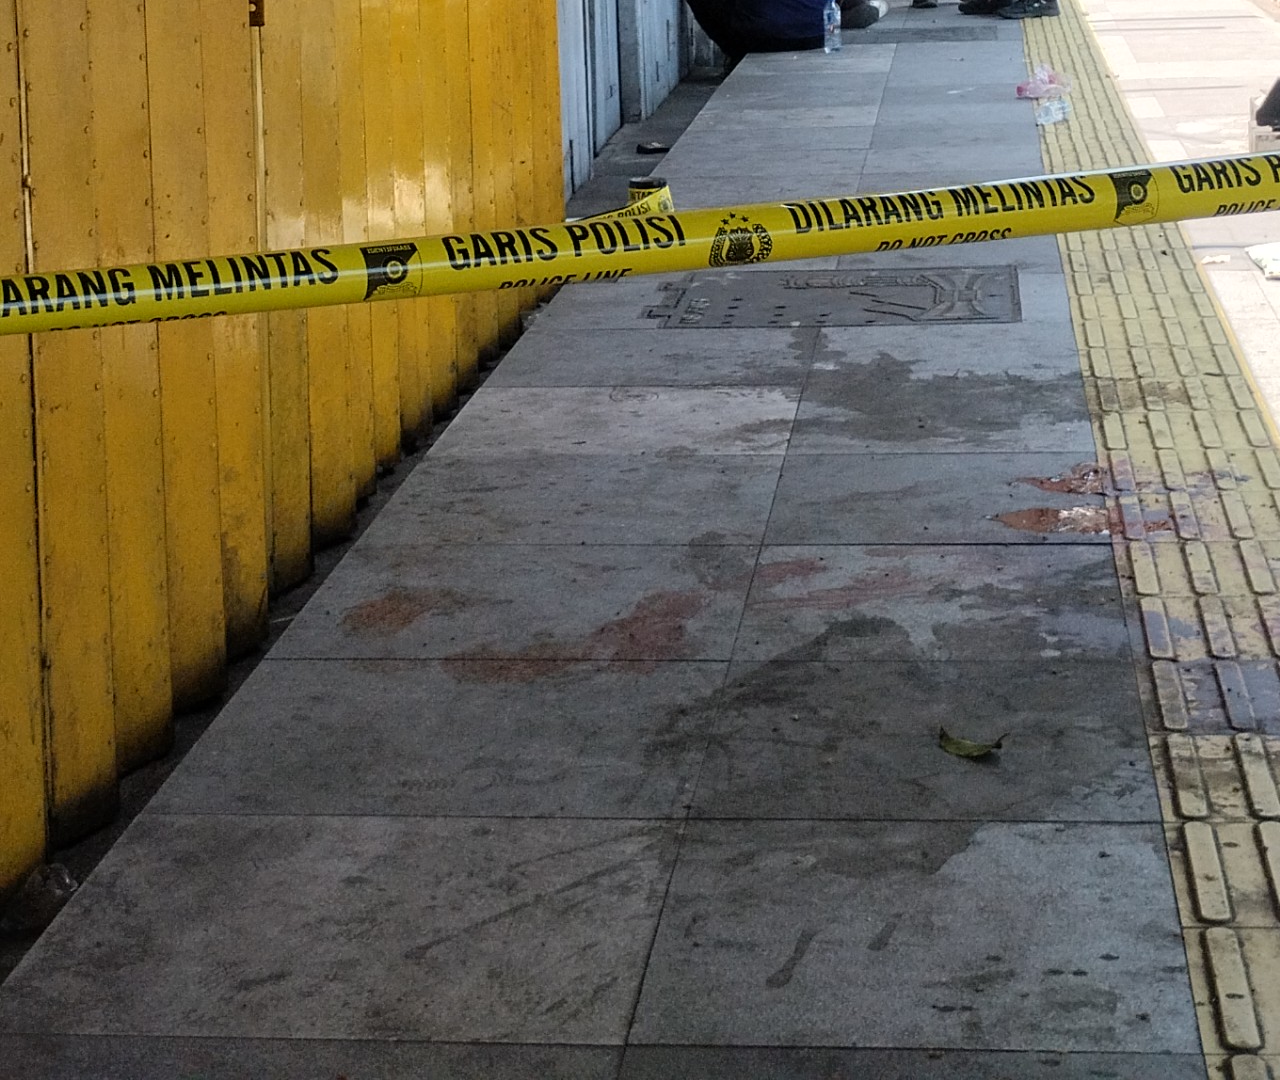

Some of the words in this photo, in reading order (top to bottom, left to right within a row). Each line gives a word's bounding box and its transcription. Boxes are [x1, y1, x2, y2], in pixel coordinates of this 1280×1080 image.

[1169, 156, 1262, 194] GARIS
[783, 191, 943, 235] DILARANG
[946, 175, 1097, 217] MELINTAS
[1212, 199, 1276, 217] POLICE
[441, 228, 558, 271] GARIS
[564, 214, 687, 258] POLISI
[146, 247, 340, 303] MELINTAS
